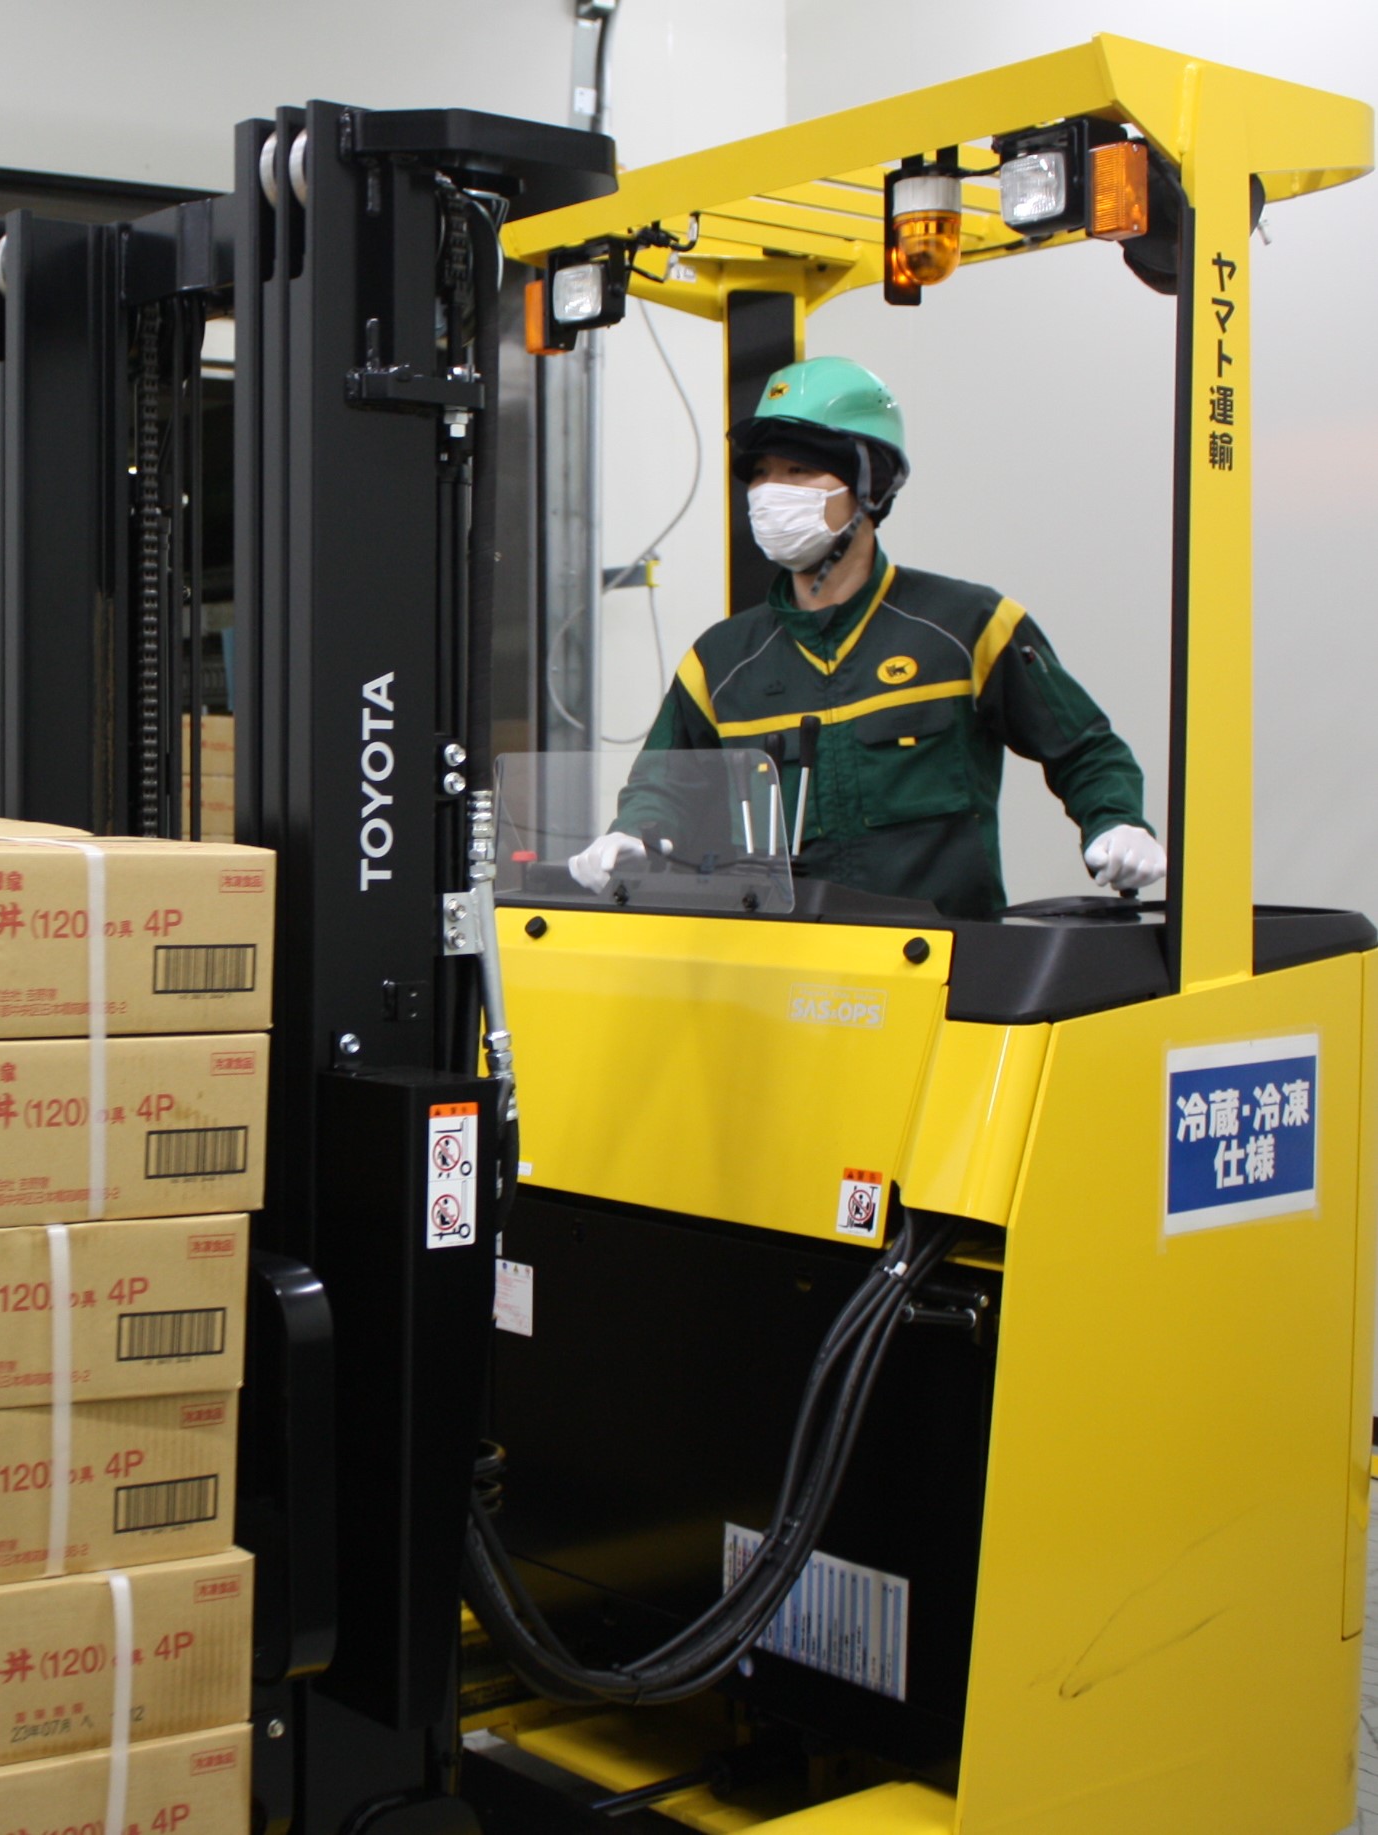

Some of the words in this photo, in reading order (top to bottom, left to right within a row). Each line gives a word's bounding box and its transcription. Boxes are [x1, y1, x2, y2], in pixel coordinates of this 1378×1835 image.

[1207, 250, 1238, 473] ヤマト運輸
[360, 671, 395, 892] TOYOTA
[143, 908, 183, 936] 4P
[136, 1093, 175, 1121] 4P
[1213, 1132, 1276, 1190] 仕様
[108, 1277, 150, 1304] 4P
[105, 1449, 145, 1478] 4P
[155, 1631, 195, 1660] 4P
